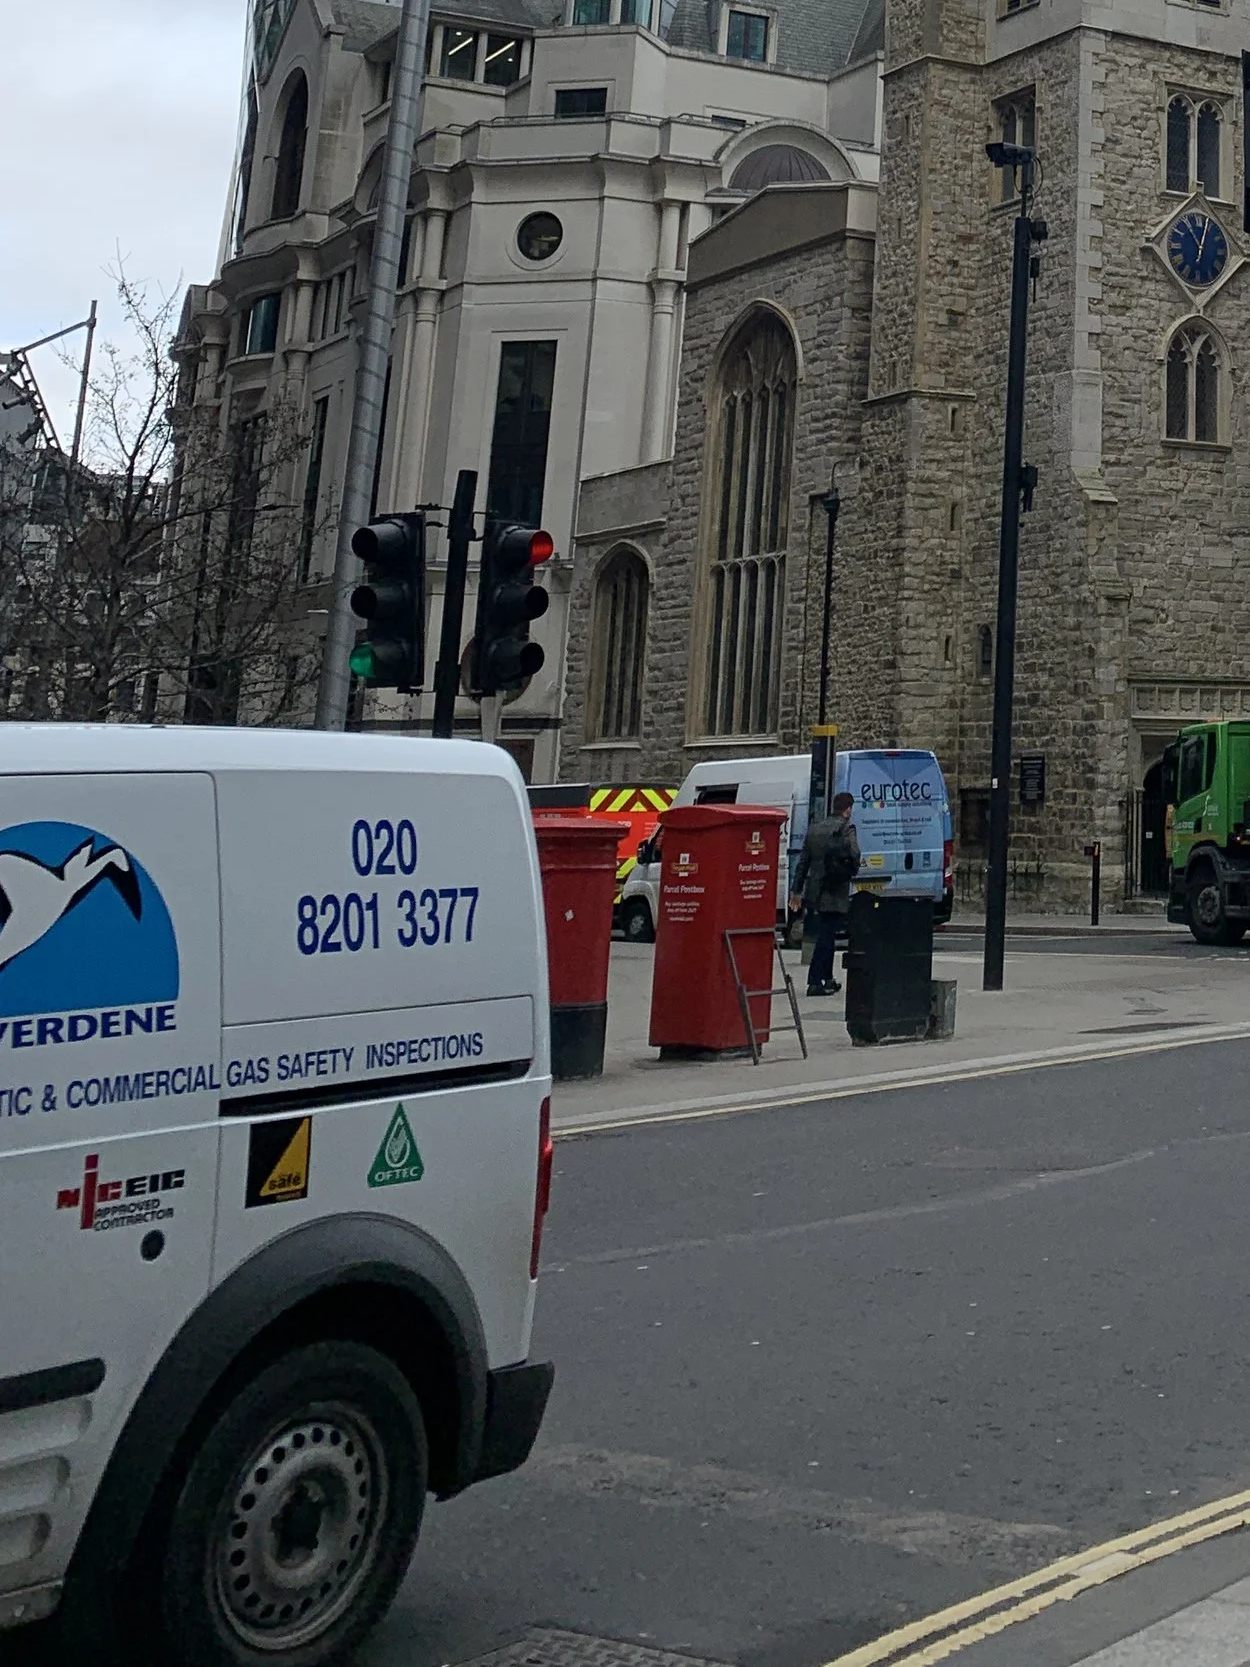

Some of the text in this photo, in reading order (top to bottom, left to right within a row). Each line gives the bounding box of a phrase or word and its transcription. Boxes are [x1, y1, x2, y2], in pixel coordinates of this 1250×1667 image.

[861, 779, 932, 802] eurotec
[352, 819, 417, 876] 020
[297, 887, 479, 955] 8201 3377
[41, 1084, 57, 1112] &
[66, 1064, 221, 1108] COMMERCIAL
[227, 1057, 270, 1087] GAS
[277, 1047, 355, 1080] SAFETY
[366, 1033, 483, 1069] INSPECTIONS
[374, 1166, 420, 1183] OFTEC
[92, 1207, 174, 1232] CONTRACTOR
[95, 1198, 161, 1220] APPROVED
